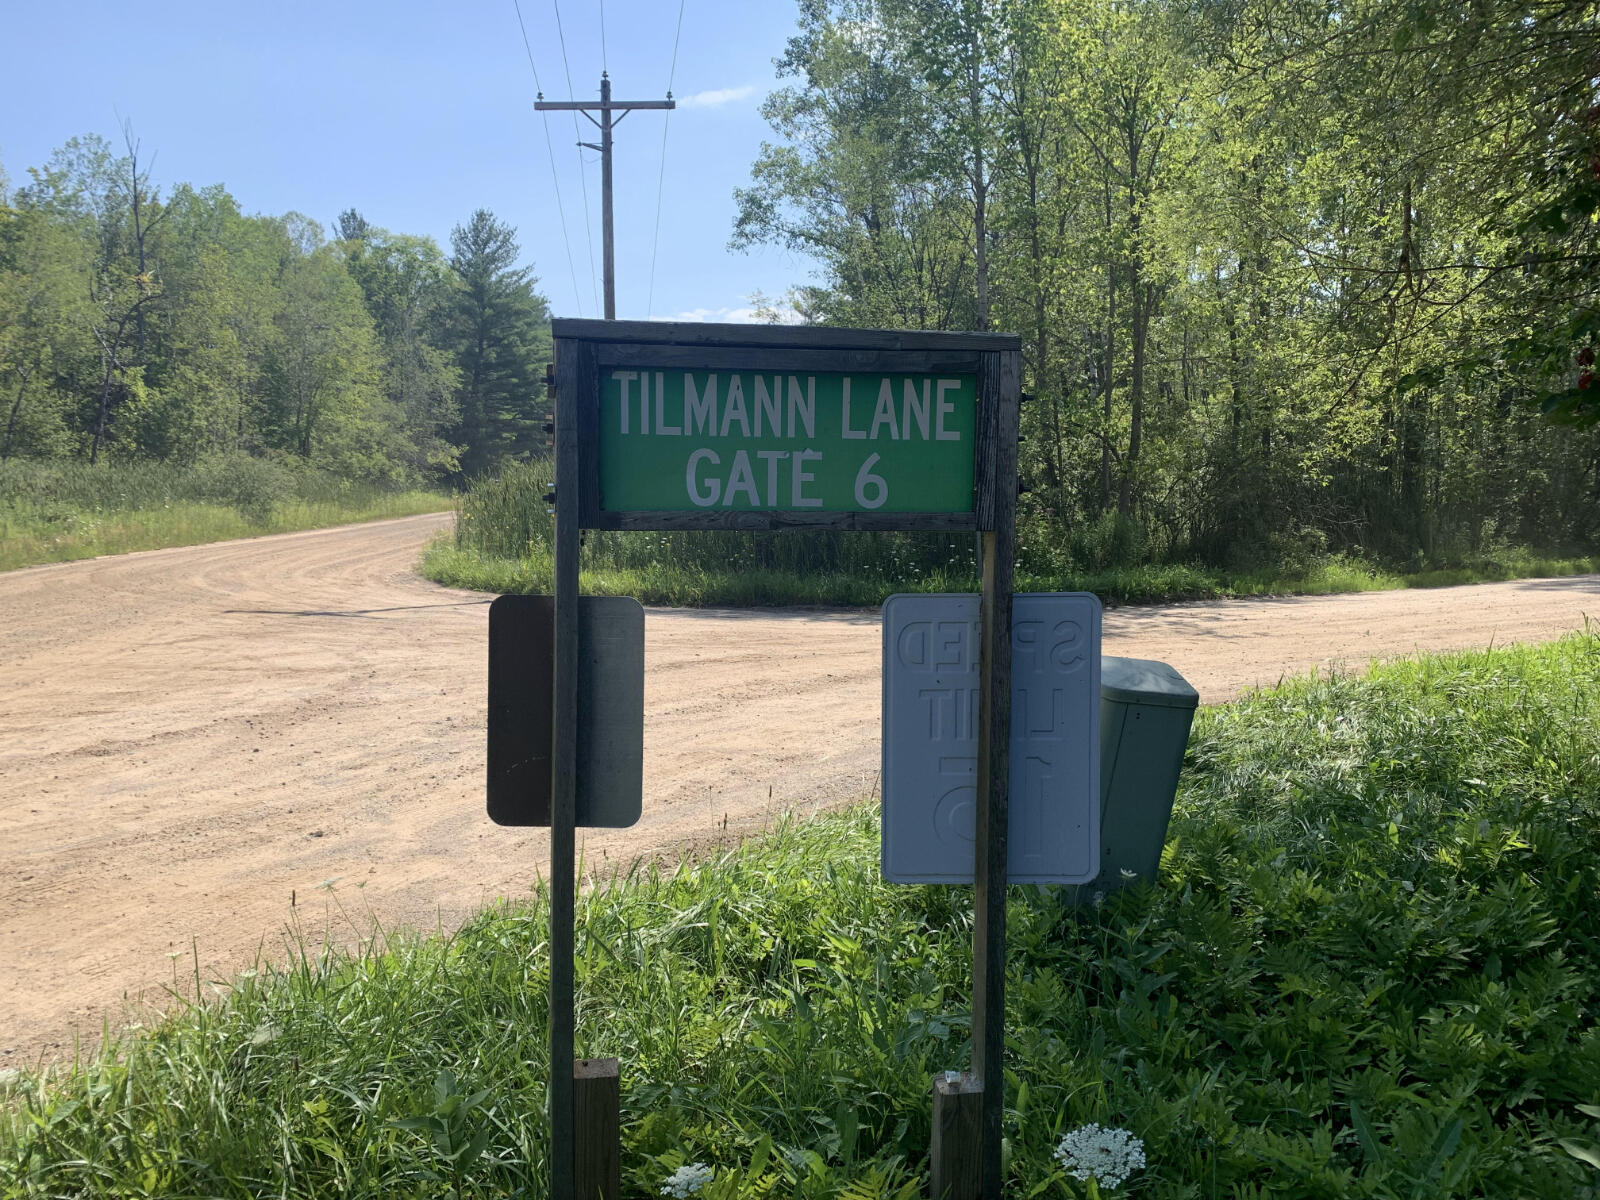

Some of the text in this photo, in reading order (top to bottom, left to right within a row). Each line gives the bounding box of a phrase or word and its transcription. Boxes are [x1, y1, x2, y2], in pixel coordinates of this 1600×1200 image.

[612, 370, 962, 441] TILMANN LANE
[685, 447, 889, 510] GATE 6
